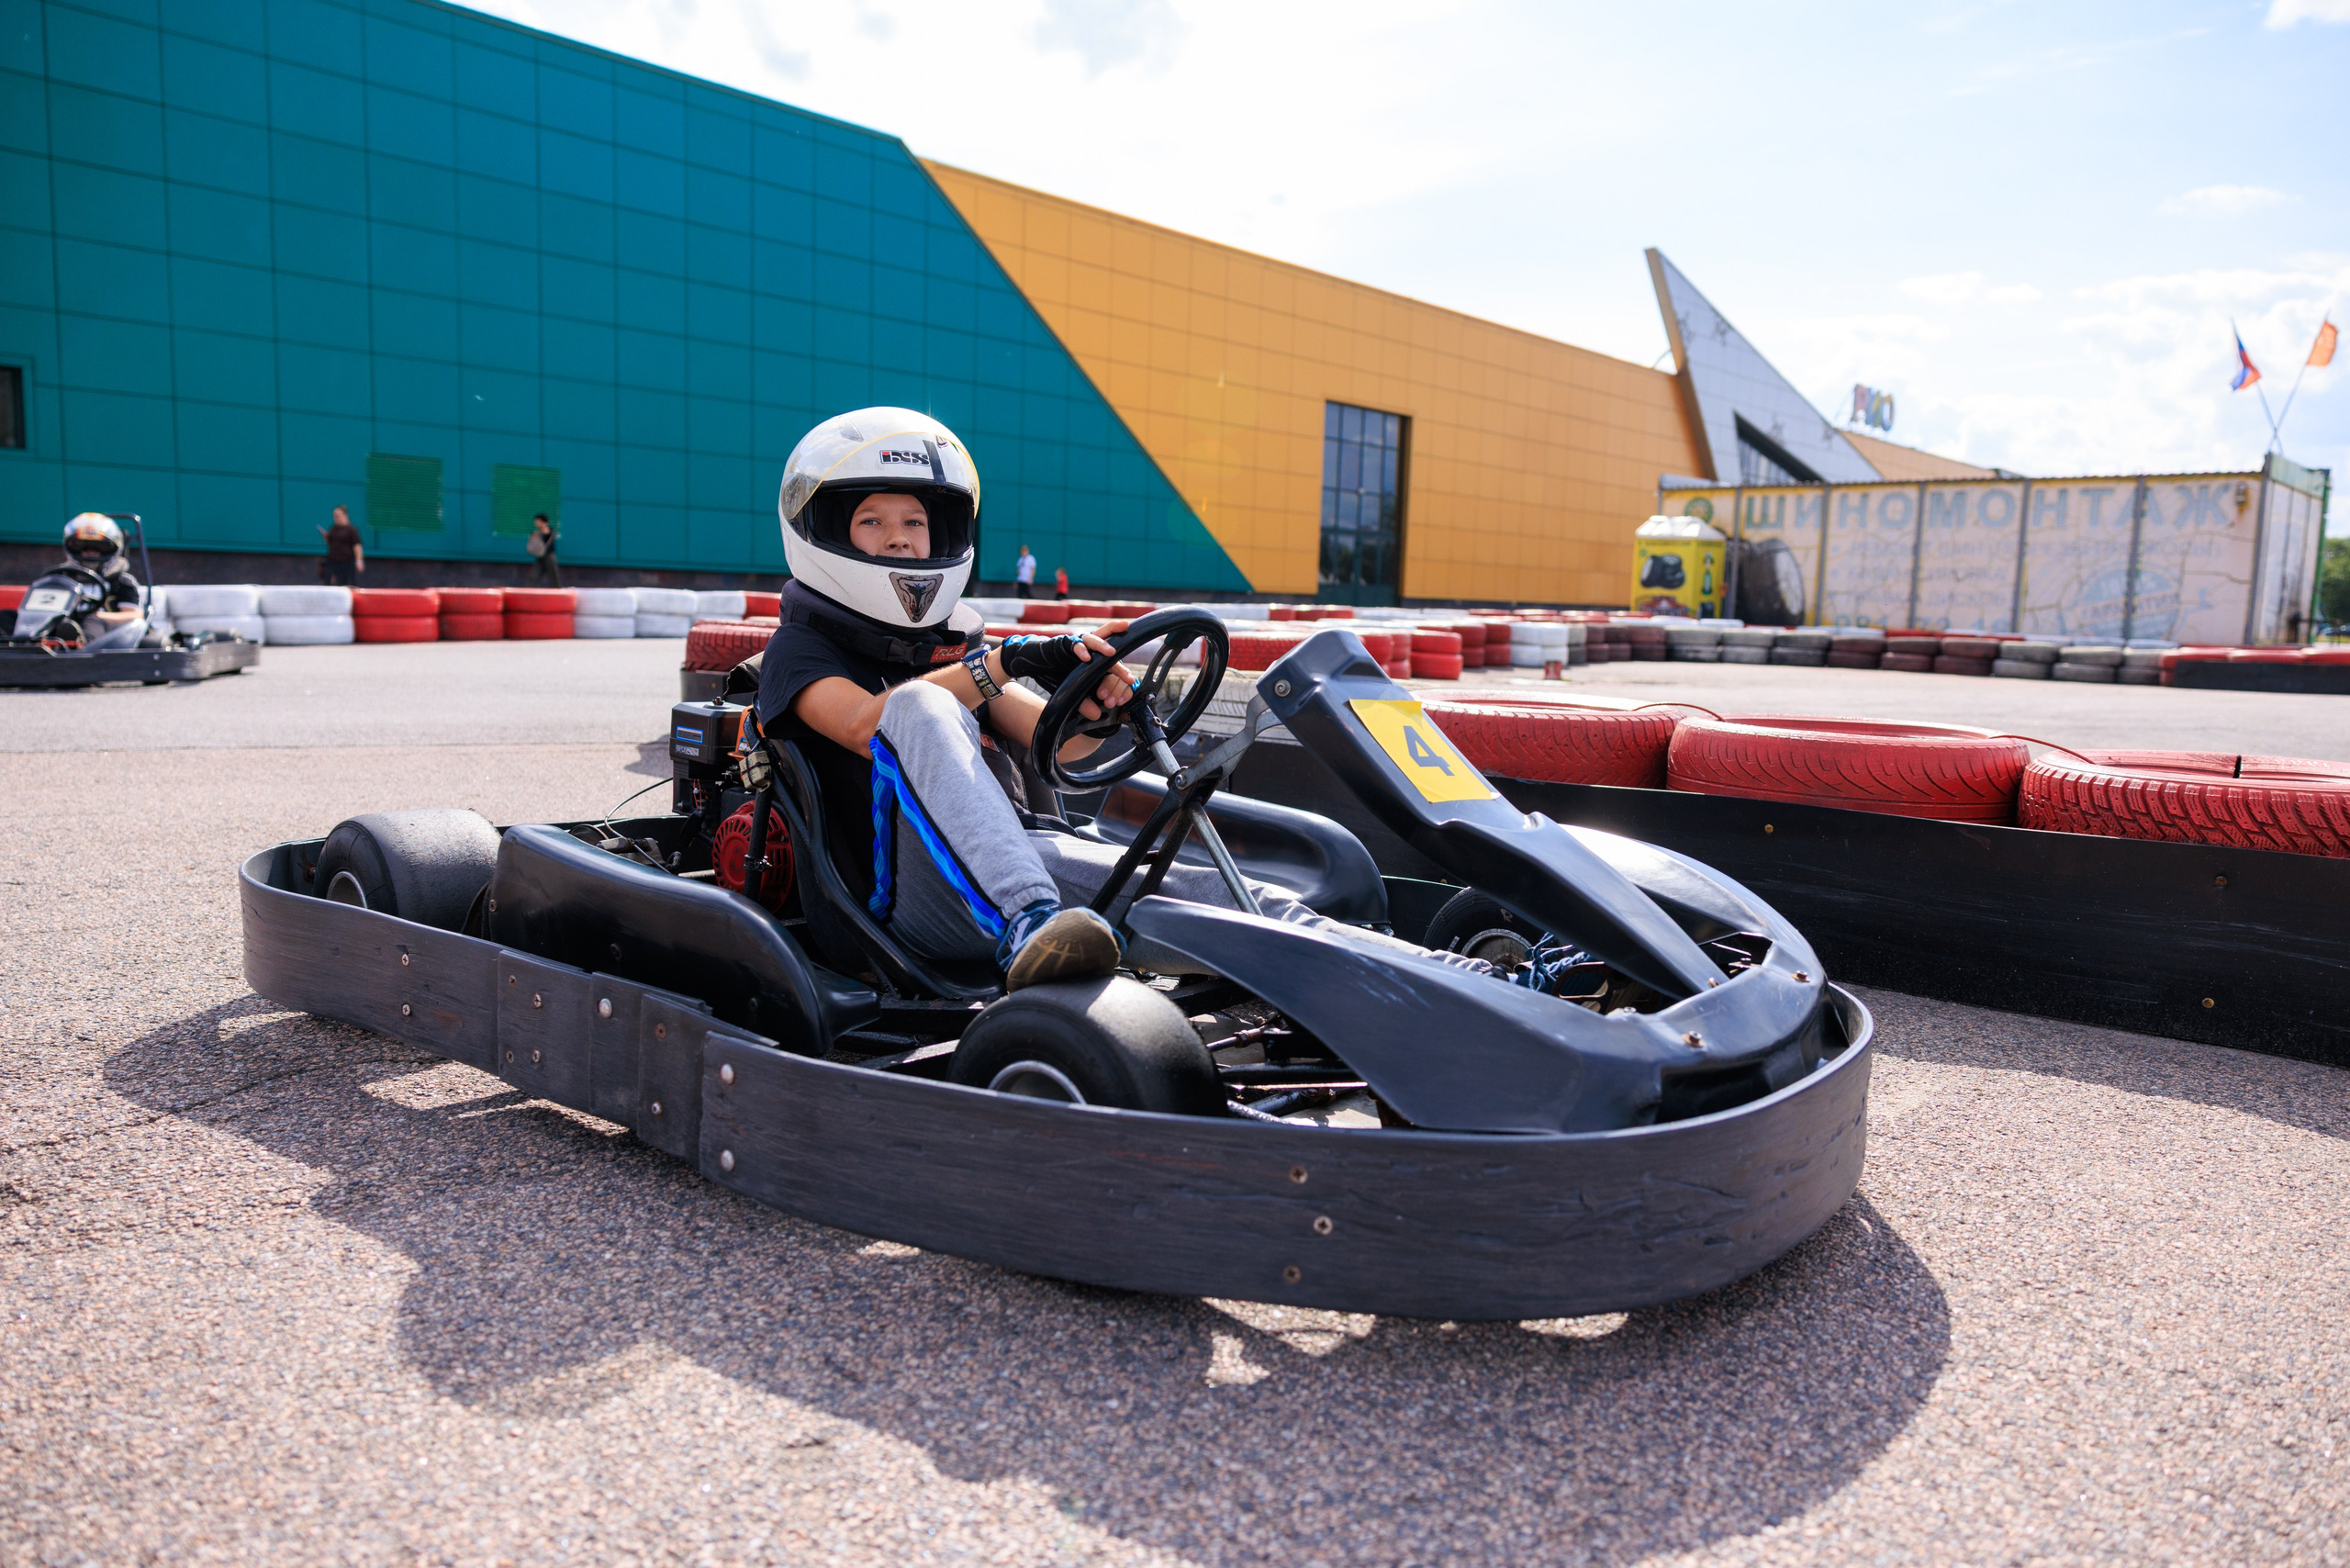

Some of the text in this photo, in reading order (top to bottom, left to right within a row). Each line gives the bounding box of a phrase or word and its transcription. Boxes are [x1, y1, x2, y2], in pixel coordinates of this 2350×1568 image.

[1746, 485, 2232, 529] ШИНОМОНТАЖ
[935, 645, 965, 657] RLG
[1403, 725, 1456, 777] 4
